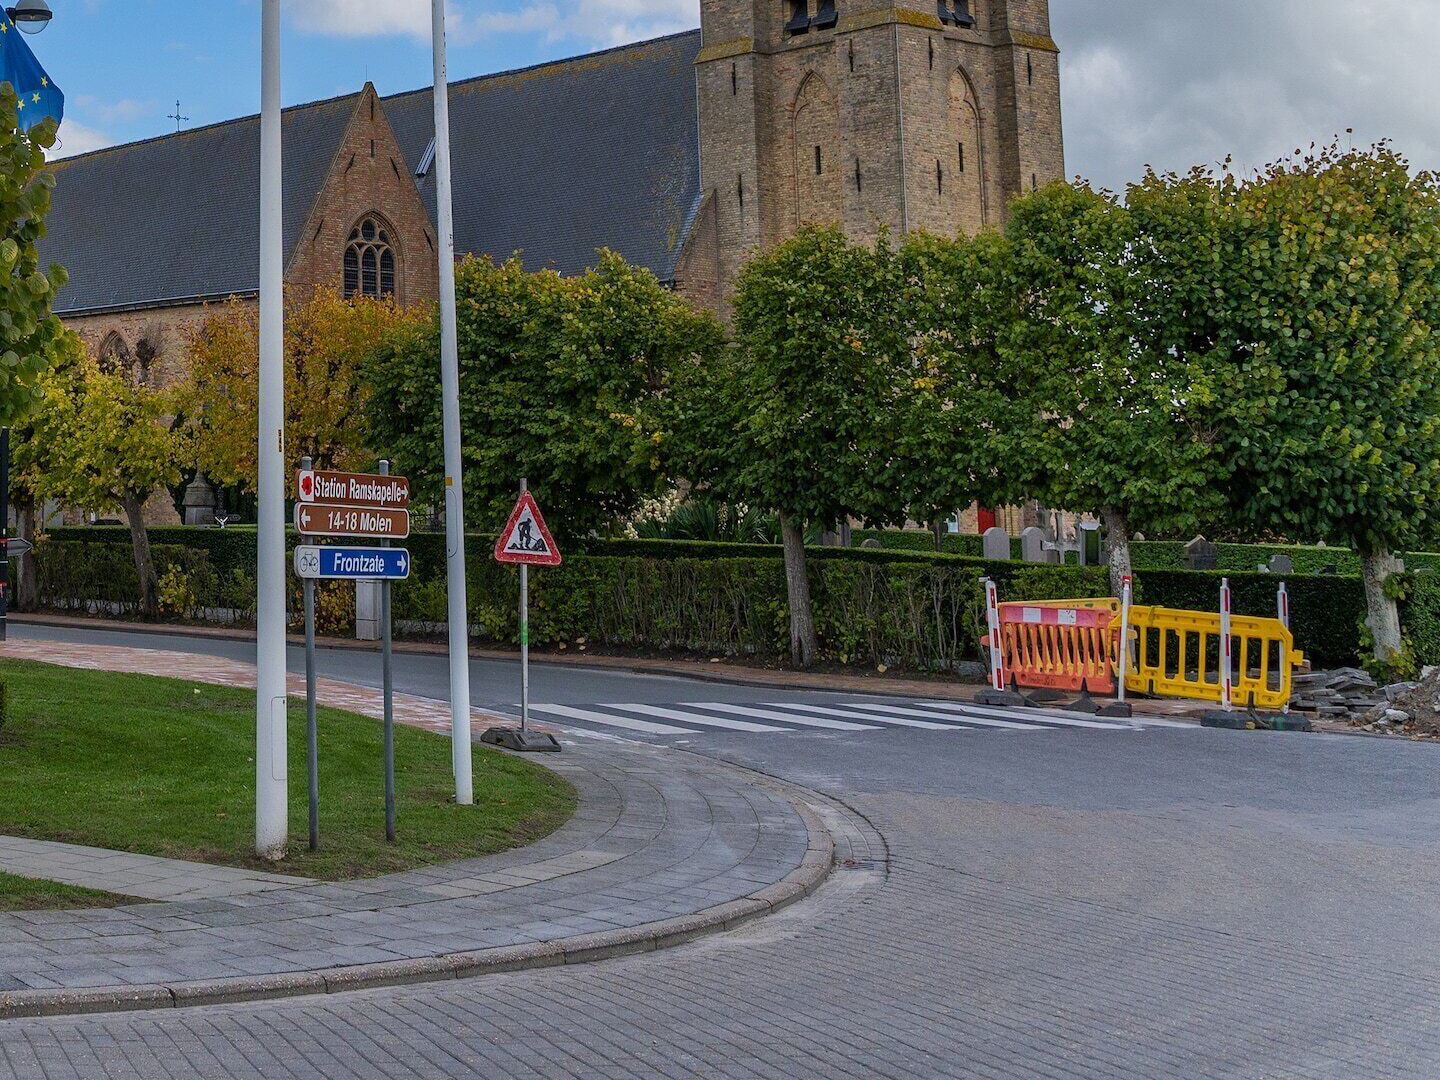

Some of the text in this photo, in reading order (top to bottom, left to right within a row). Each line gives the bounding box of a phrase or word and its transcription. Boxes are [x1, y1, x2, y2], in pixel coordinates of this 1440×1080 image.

[314, 476, 402, 506] Station Ramskapelle
[328, 511, 393, 532] 14-18 Molen
[333, 552, 385, 573] Frontzate
